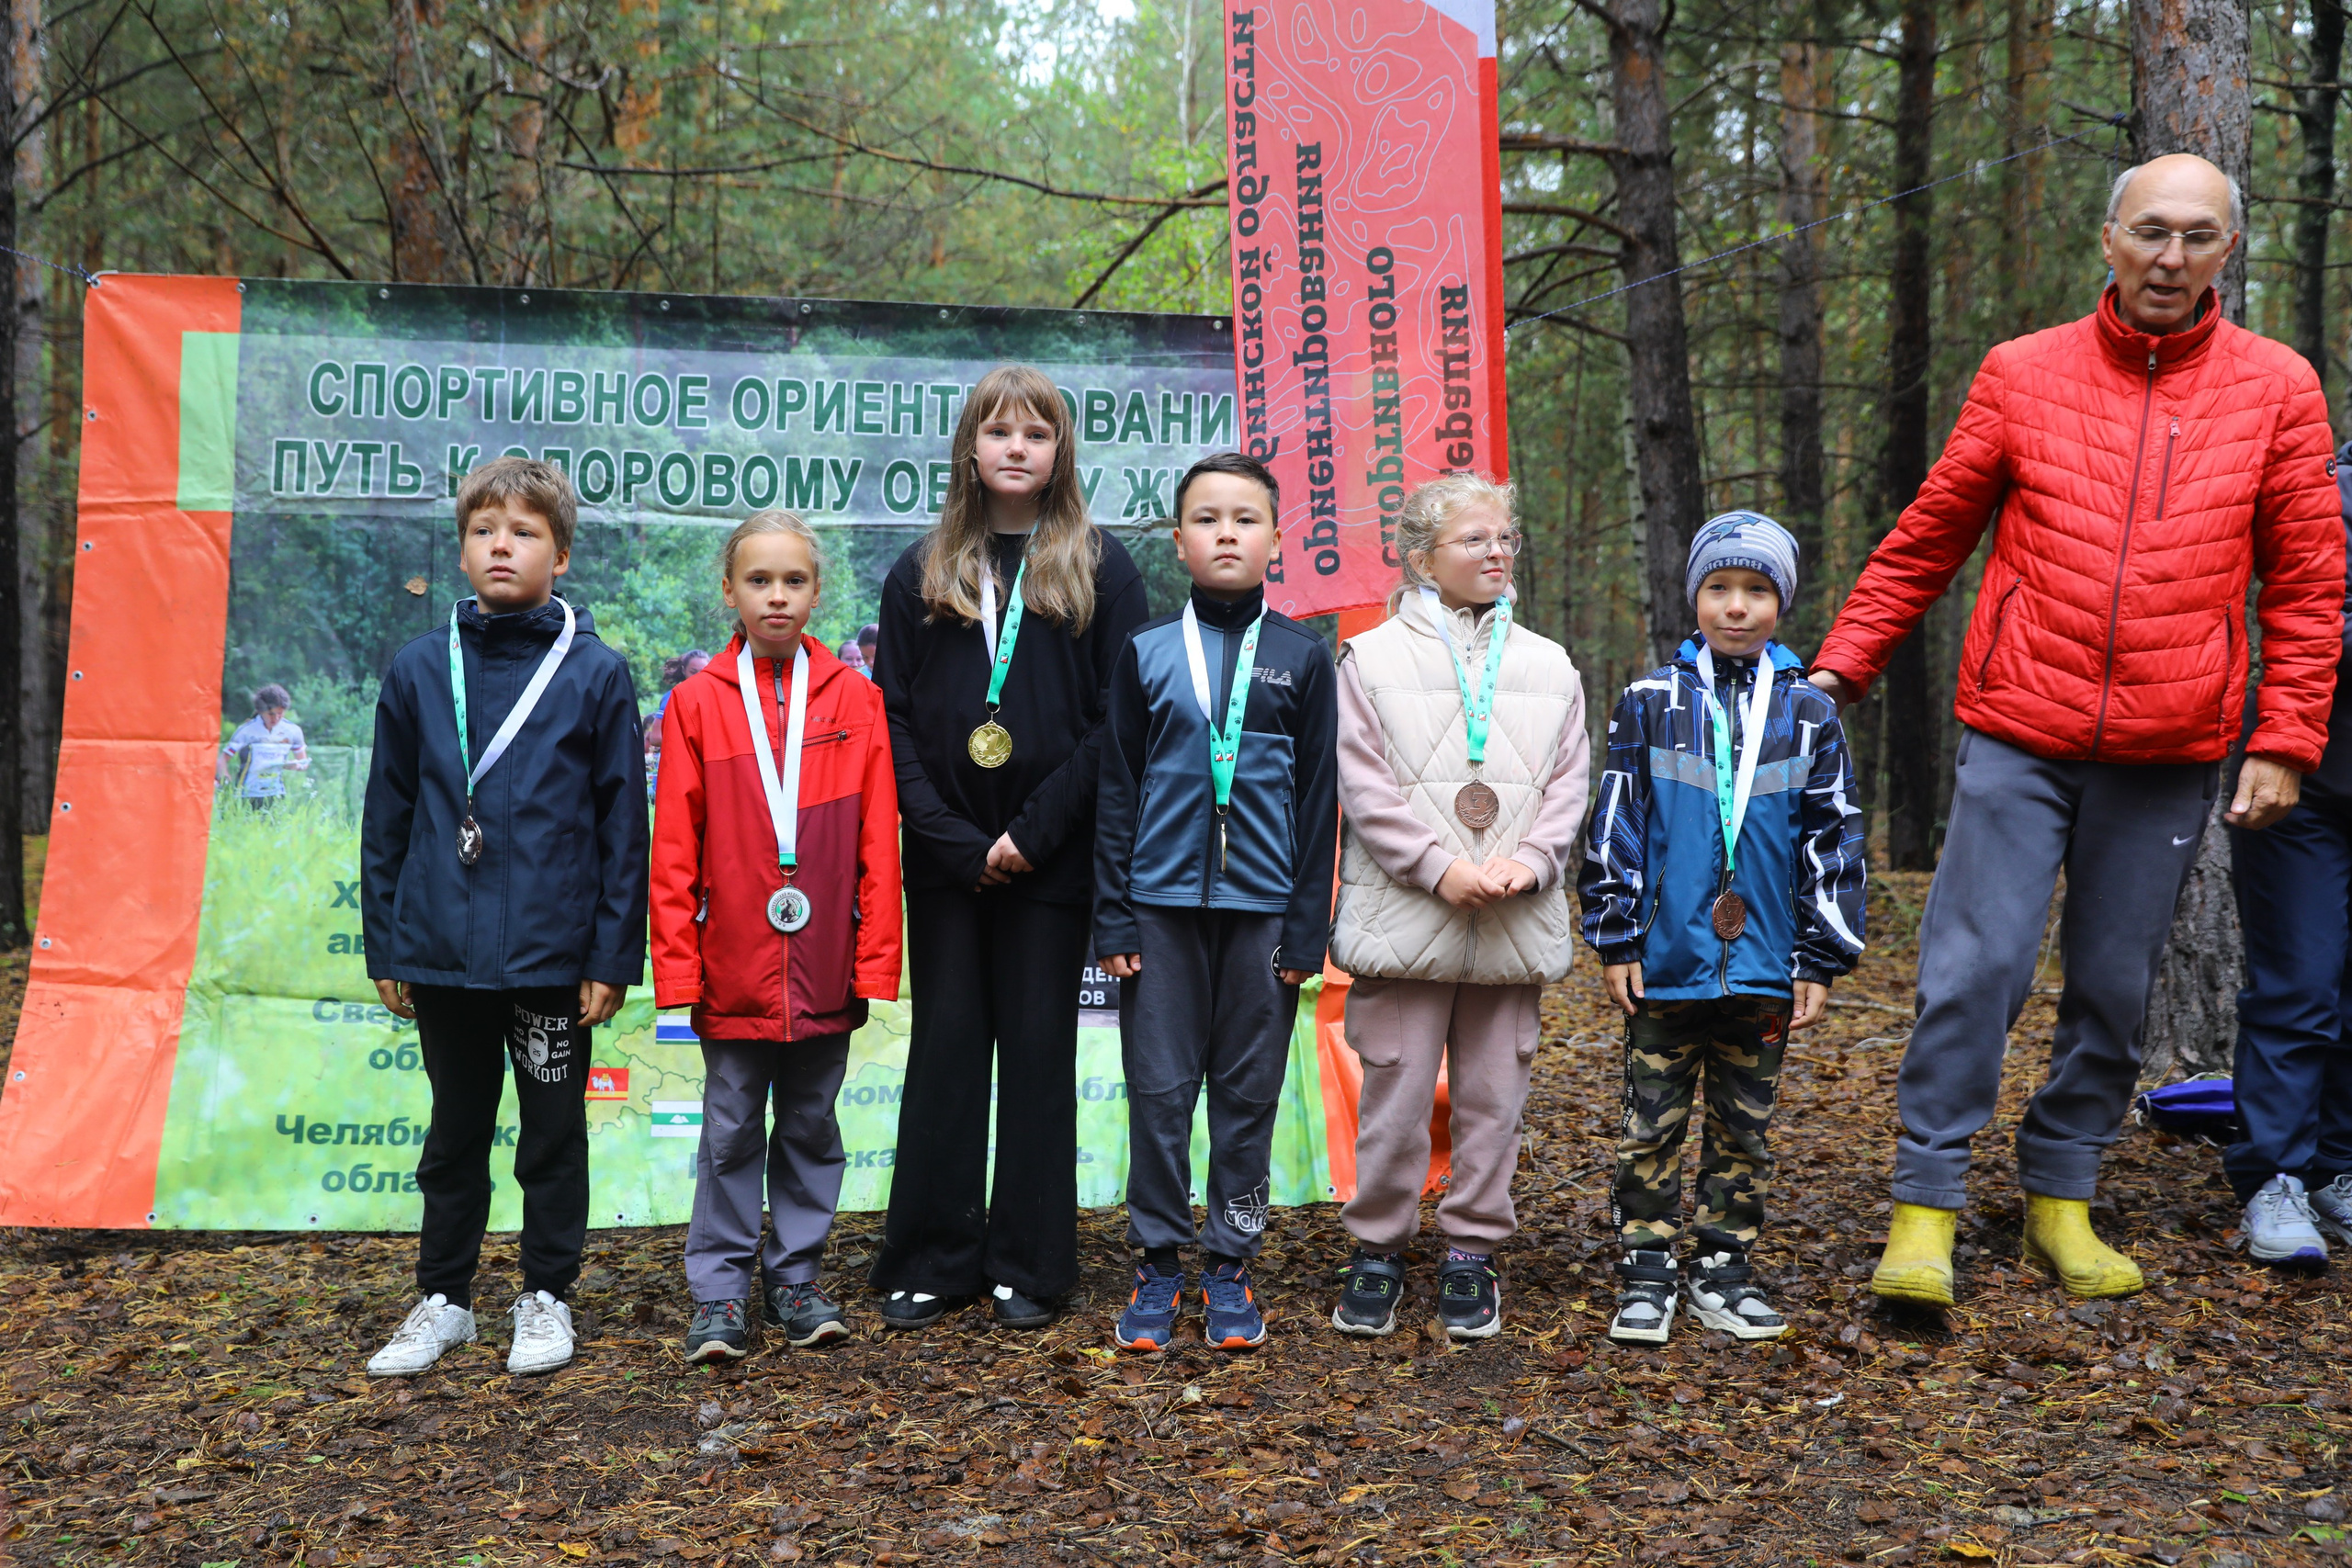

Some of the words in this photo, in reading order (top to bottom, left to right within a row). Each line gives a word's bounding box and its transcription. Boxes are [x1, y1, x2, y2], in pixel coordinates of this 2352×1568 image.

[308, 360, 710, 430] СПОРТИВНОЕ
[731, 375, 1239, 447] ОРИЕНТВАНИ
[273, 437, 424, 498] ПУТЬ
[501, 445, 863, 514] ОРОВОМУ
[514, 1003, 569, 1031] POWER
[533, 1048, 541, 1057] 25
[551, 1049, 571, 1059] GAIN
[556, 1040, 570, 1048] NO
[514, 1046, 568, 1083] WORKOUT
